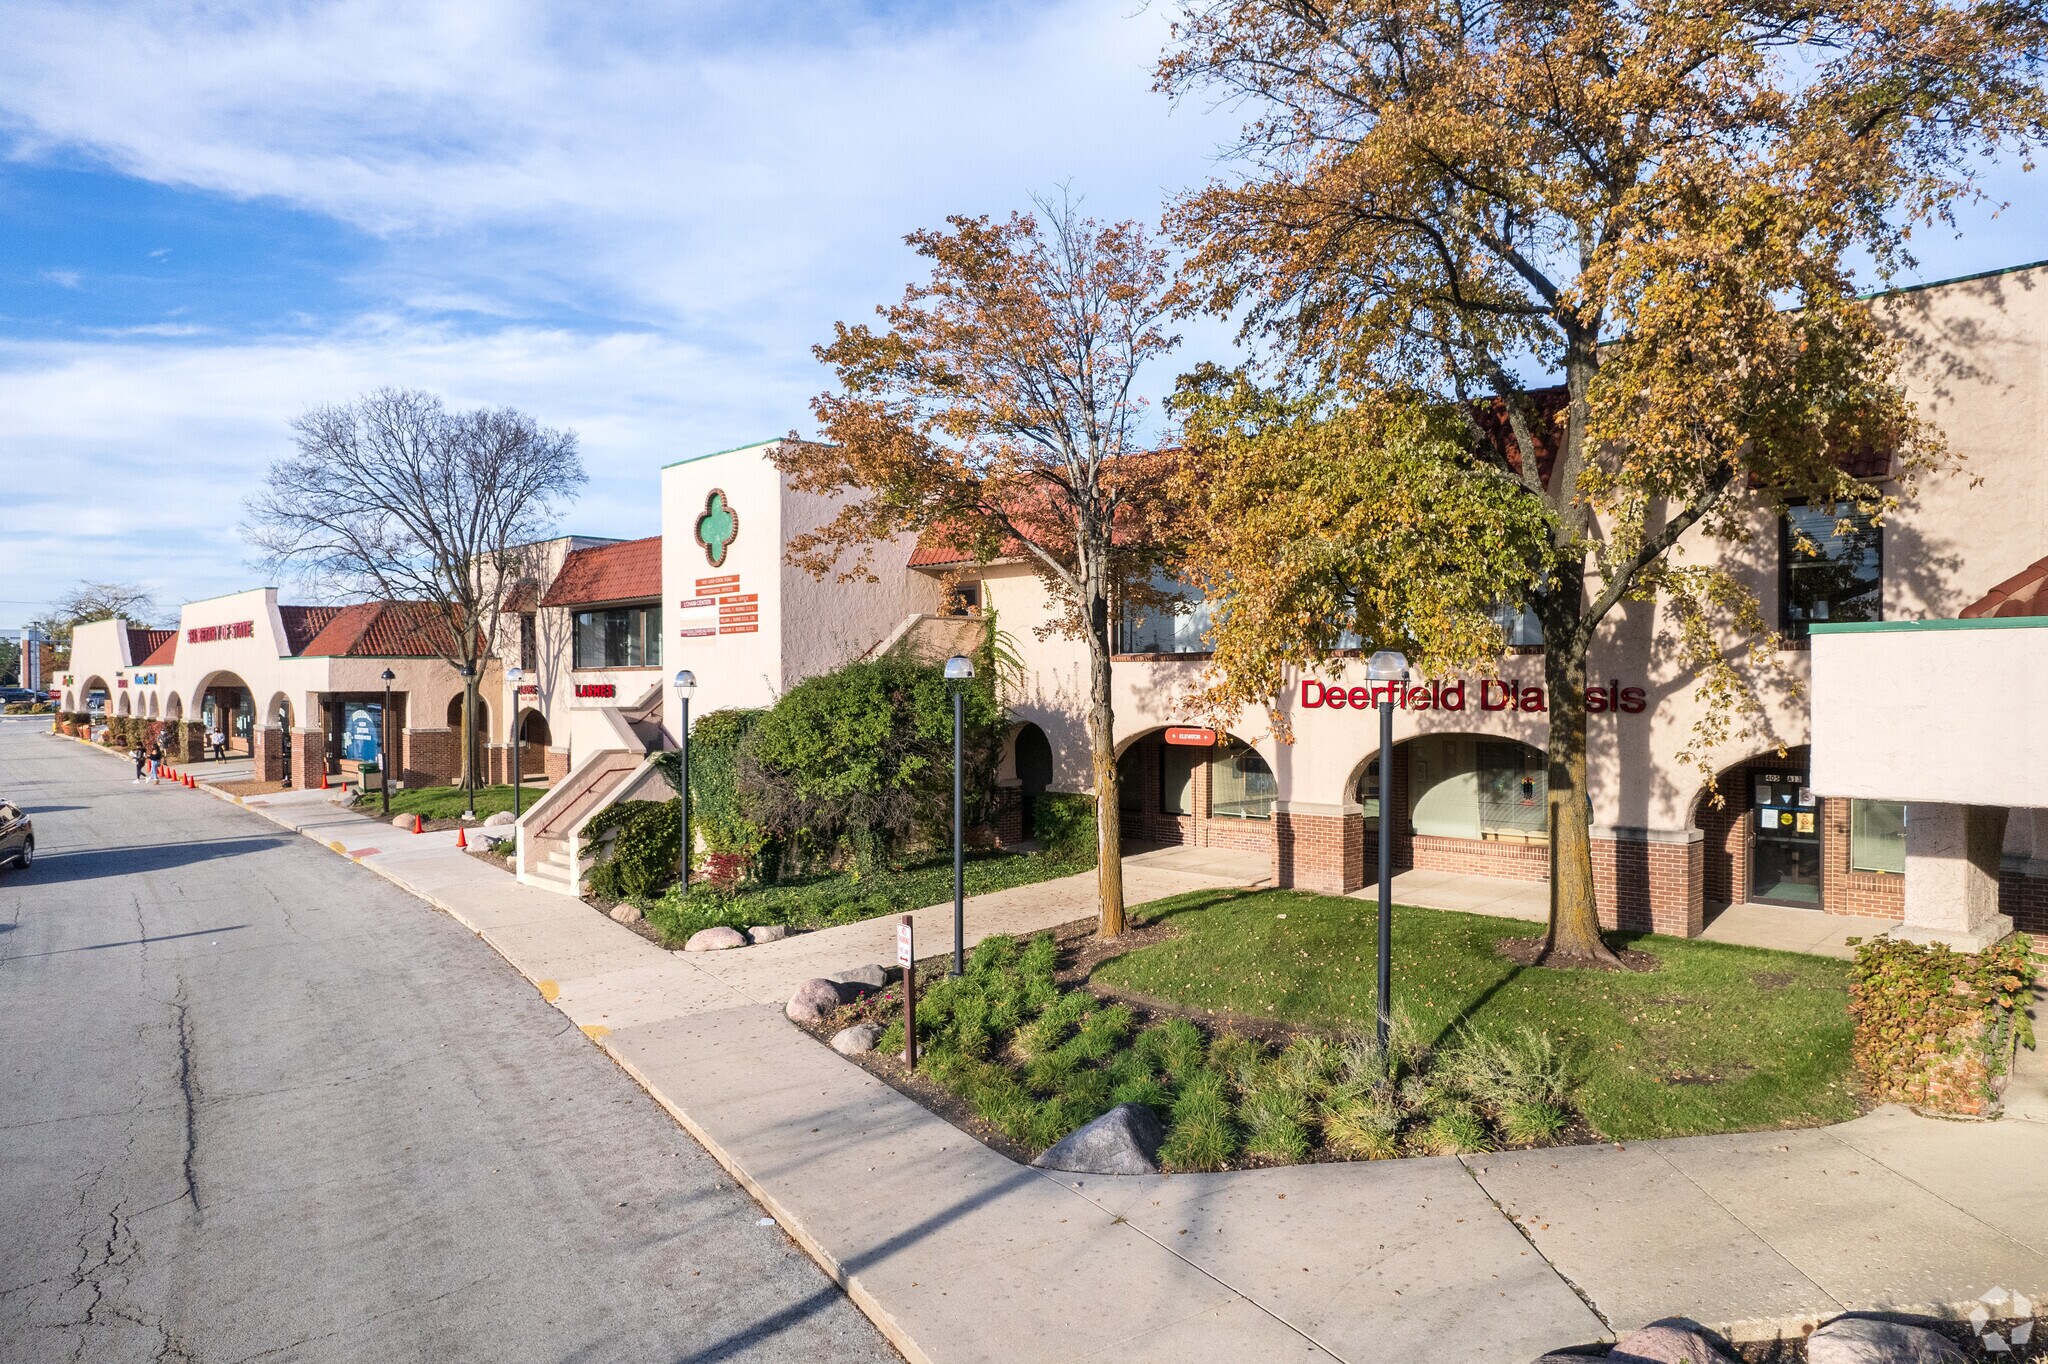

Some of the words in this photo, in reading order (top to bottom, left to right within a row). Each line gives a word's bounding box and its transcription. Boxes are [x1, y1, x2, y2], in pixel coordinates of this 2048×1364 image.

[575, 684, 615, 698] LASHES
[1302, 679, 1465, 712] Deerfield
[1480, 679, 1646, 713] Diasis
